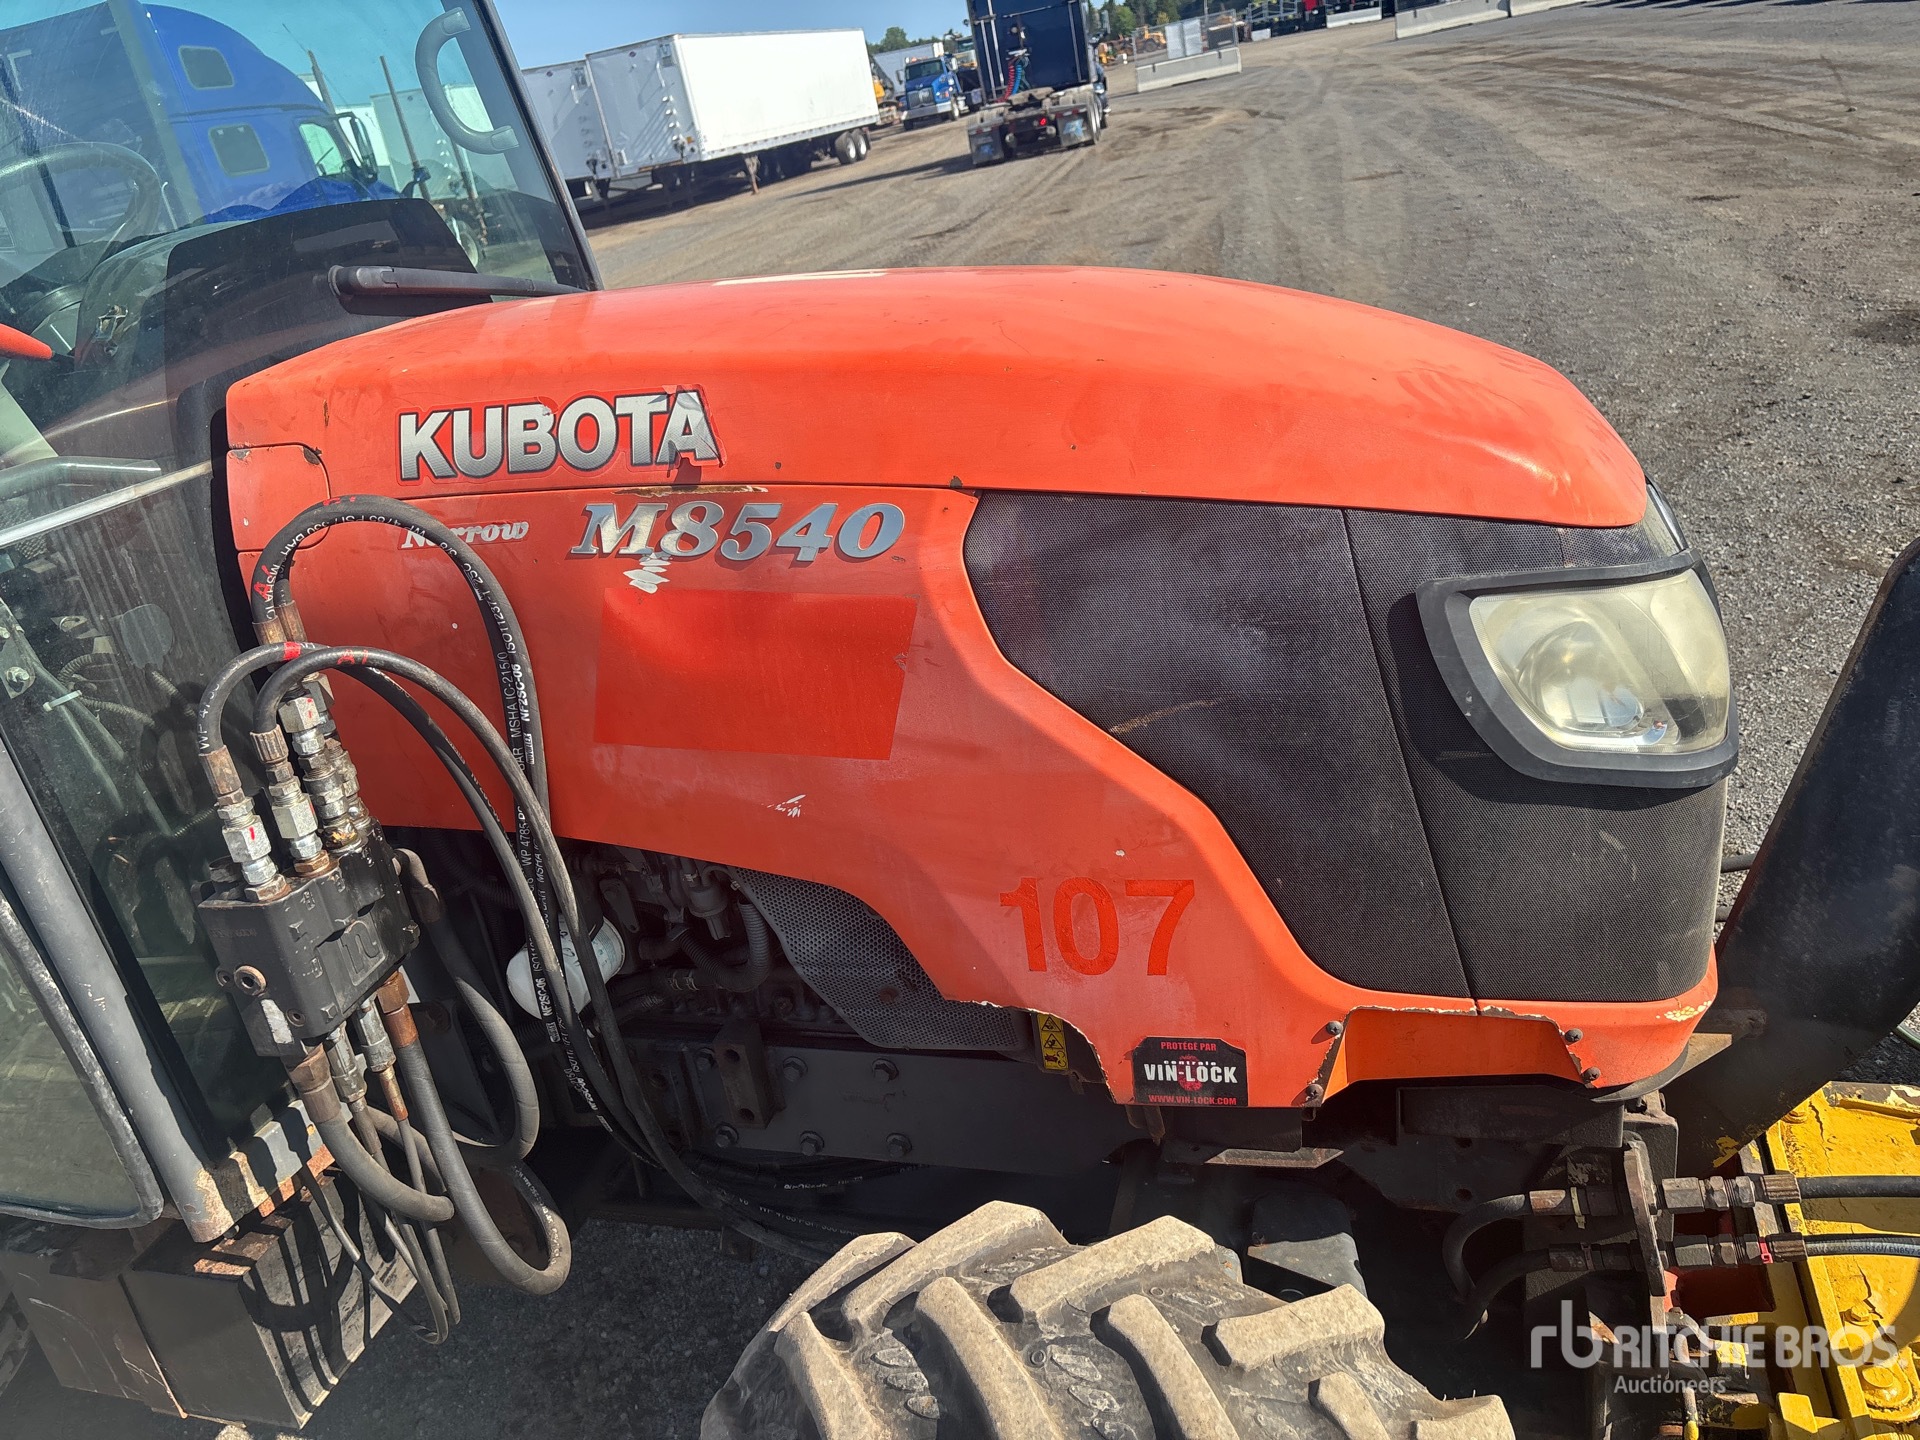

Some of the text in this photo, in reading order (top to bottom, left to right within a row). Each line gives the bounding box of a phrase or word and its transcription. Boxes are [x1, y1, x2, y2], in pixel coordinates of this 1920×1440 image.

[399, 390, 723, 481] KUBOTA
[401, 521, 529, 549] Nrrow
[570, 500, 906, 563] M8540
[511, 663, 531, 722] NF2SC-06
[506, 702, 522, 739] MSHA
[518, 822, 531, 848] 4785
[521, 849, 532, 866] WP
[1000, 876, 1195, 976] 107
[1200, 1042, 1217, 1051] PAR
[1144, 1063, 1238, 1083] VIN-LOCK
[1148, 1094, 1237, 1105] WWW.VIN-LOCK.COM
